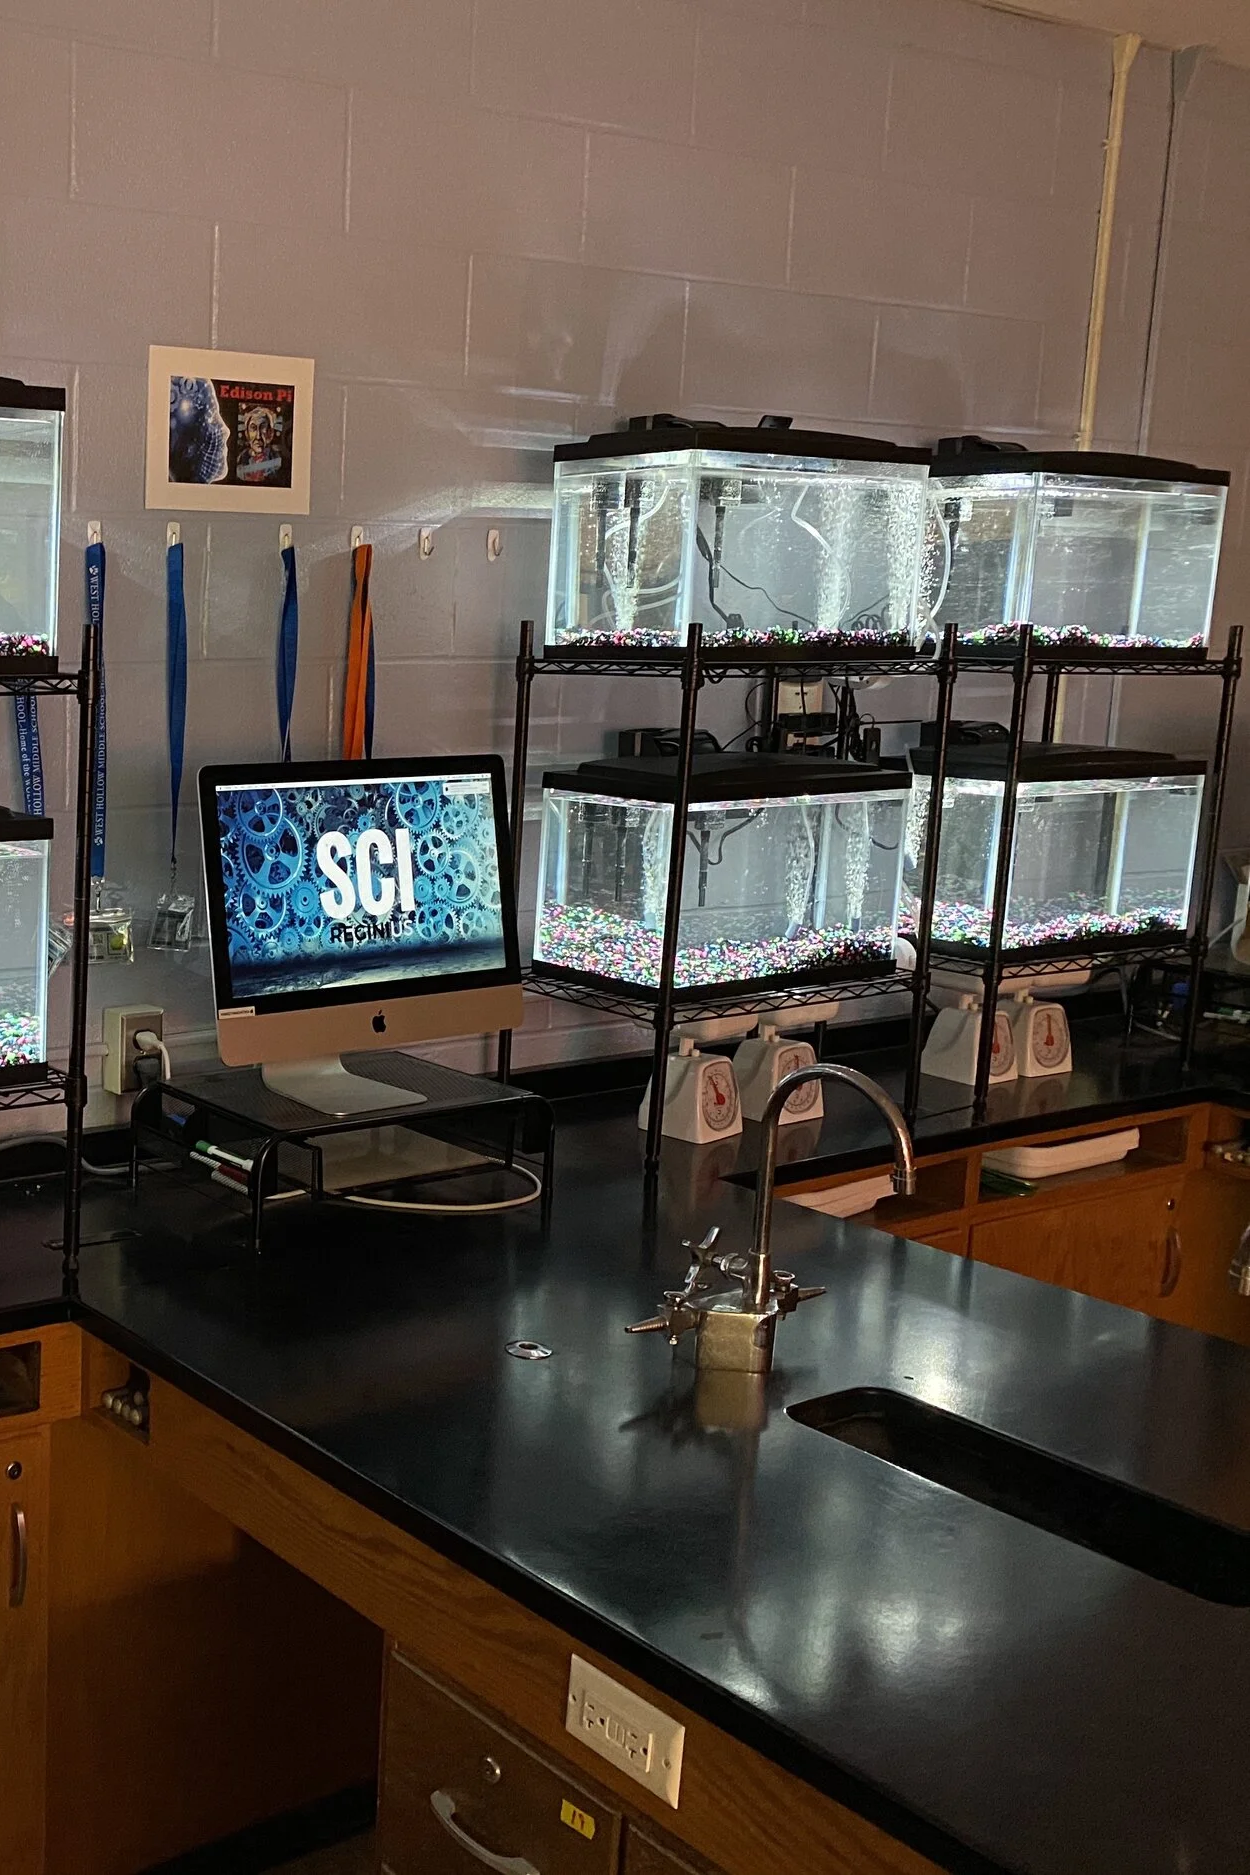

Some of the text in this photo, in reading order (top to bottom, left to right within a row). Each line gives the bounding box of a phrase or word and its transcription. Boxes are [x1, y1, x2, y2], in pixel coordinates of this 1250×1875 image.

[220, 384, 273, 401] Edison
[90, 575, 100, 624] WEST HOL
[31, 736, 40, 772] MIDDLE
[98, 733, 106, 768] MIDDLE
[32, 774, 42, 815] HOLLOW
[96, 770, 105, 810] HOLLOW
[94, 811, 104, 836] WEST
[316, 828, 416, 920] SCI
